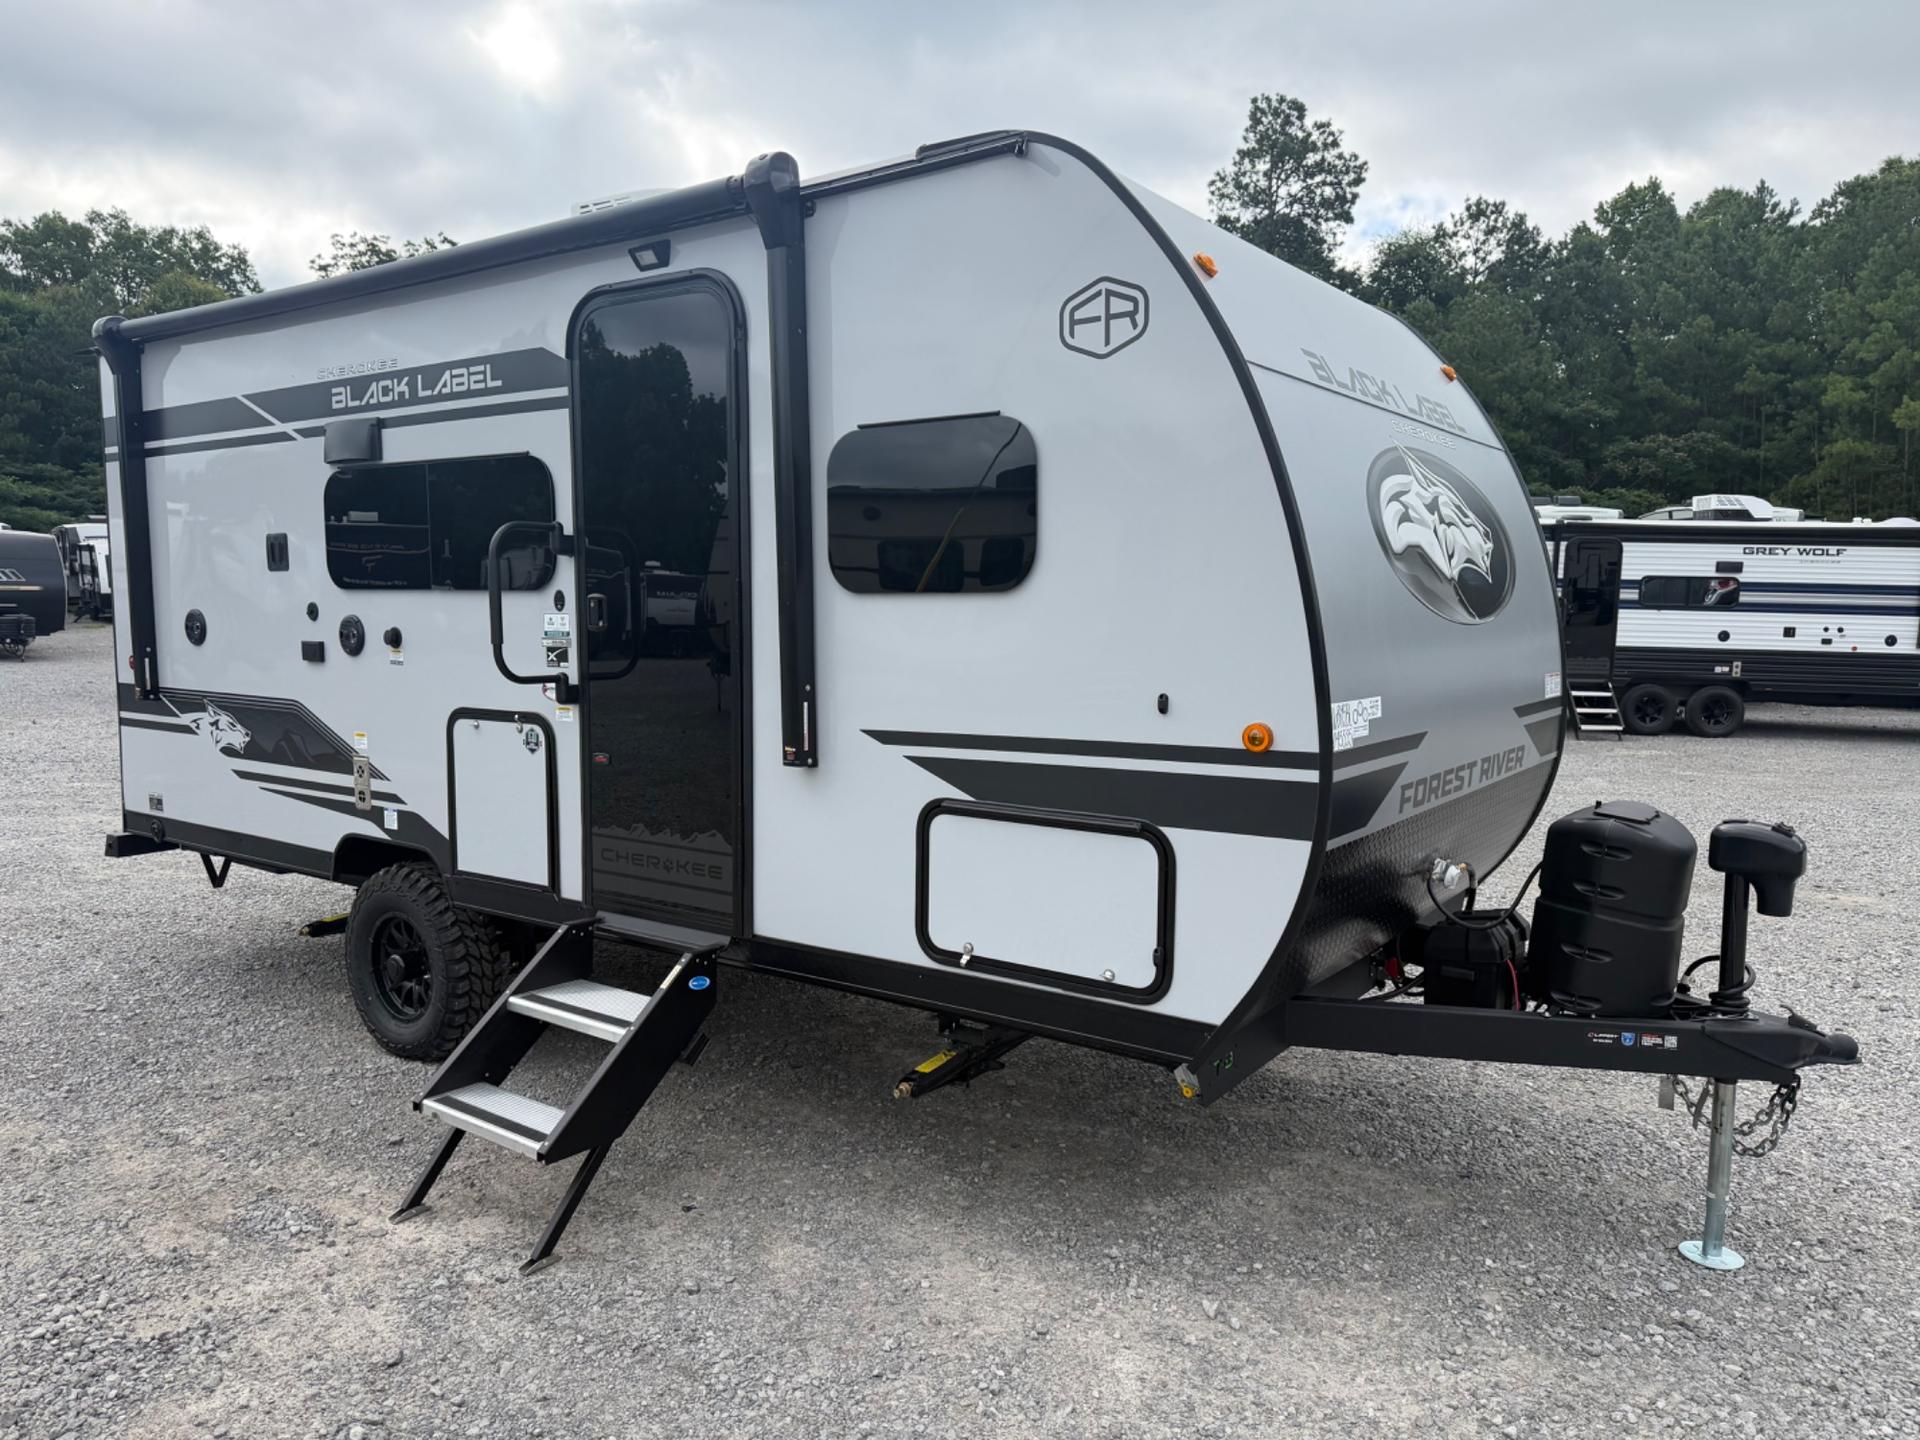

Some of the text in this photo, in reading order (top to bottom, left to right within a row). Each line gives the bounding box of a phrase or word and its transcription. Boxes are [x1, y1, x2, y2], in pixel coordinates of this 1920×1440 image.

[316, 358, 398, 380] CHEROKEE
[331, 363, 502, 409] BLACK LABEL
[1300, 347, 1467, 434] BLACK LABEL
[1391, 419, 1457, 450] CHEROKEE
[1743, 546, 1847, 557] GREY WOLF
[1398, 744, 1526, 815] FOREST RIVER
